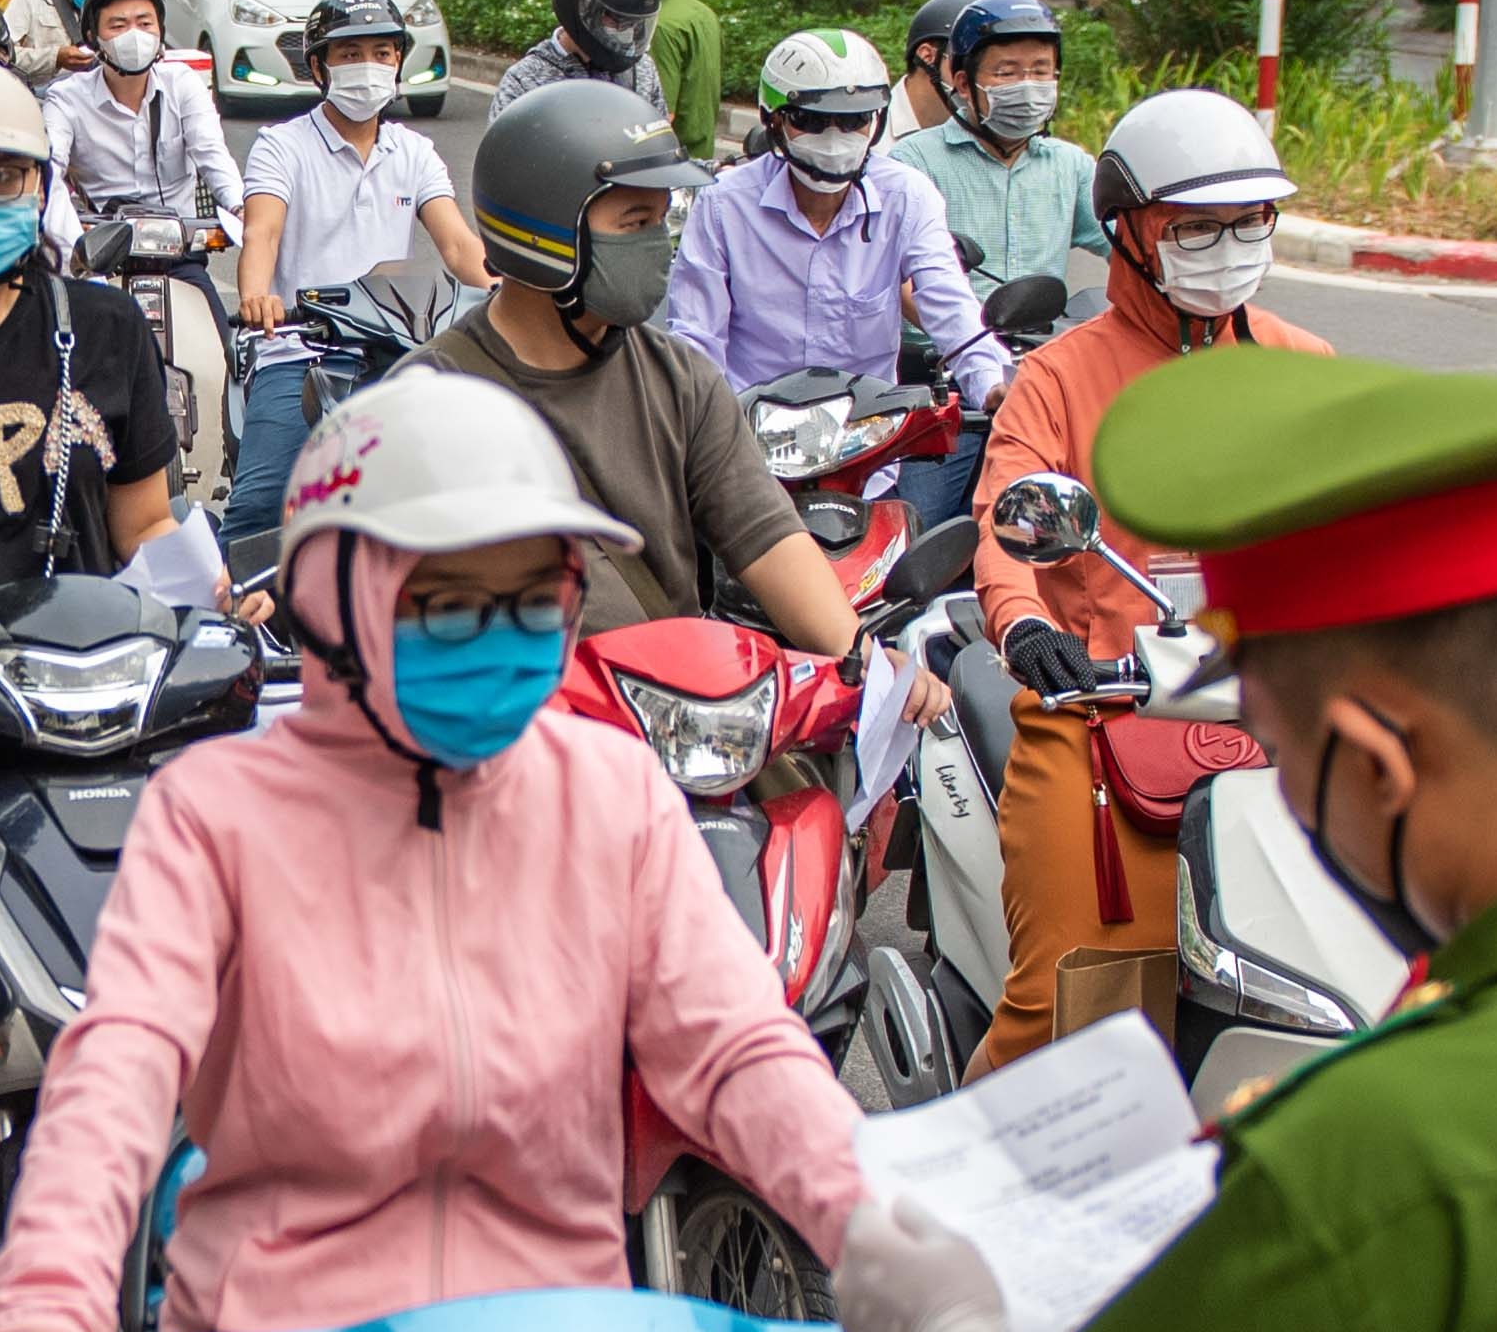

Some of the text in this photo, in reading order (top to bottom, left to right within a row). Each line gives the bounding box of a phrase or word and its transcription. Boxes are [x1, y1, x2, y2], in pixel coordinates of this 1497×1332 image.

[807, 502, 858, 516] HONDA
[68, 787, 132, 802] HONDA
[935, 763, 971, 820] Liberty
[697, 820, 740, 833] ONDA
